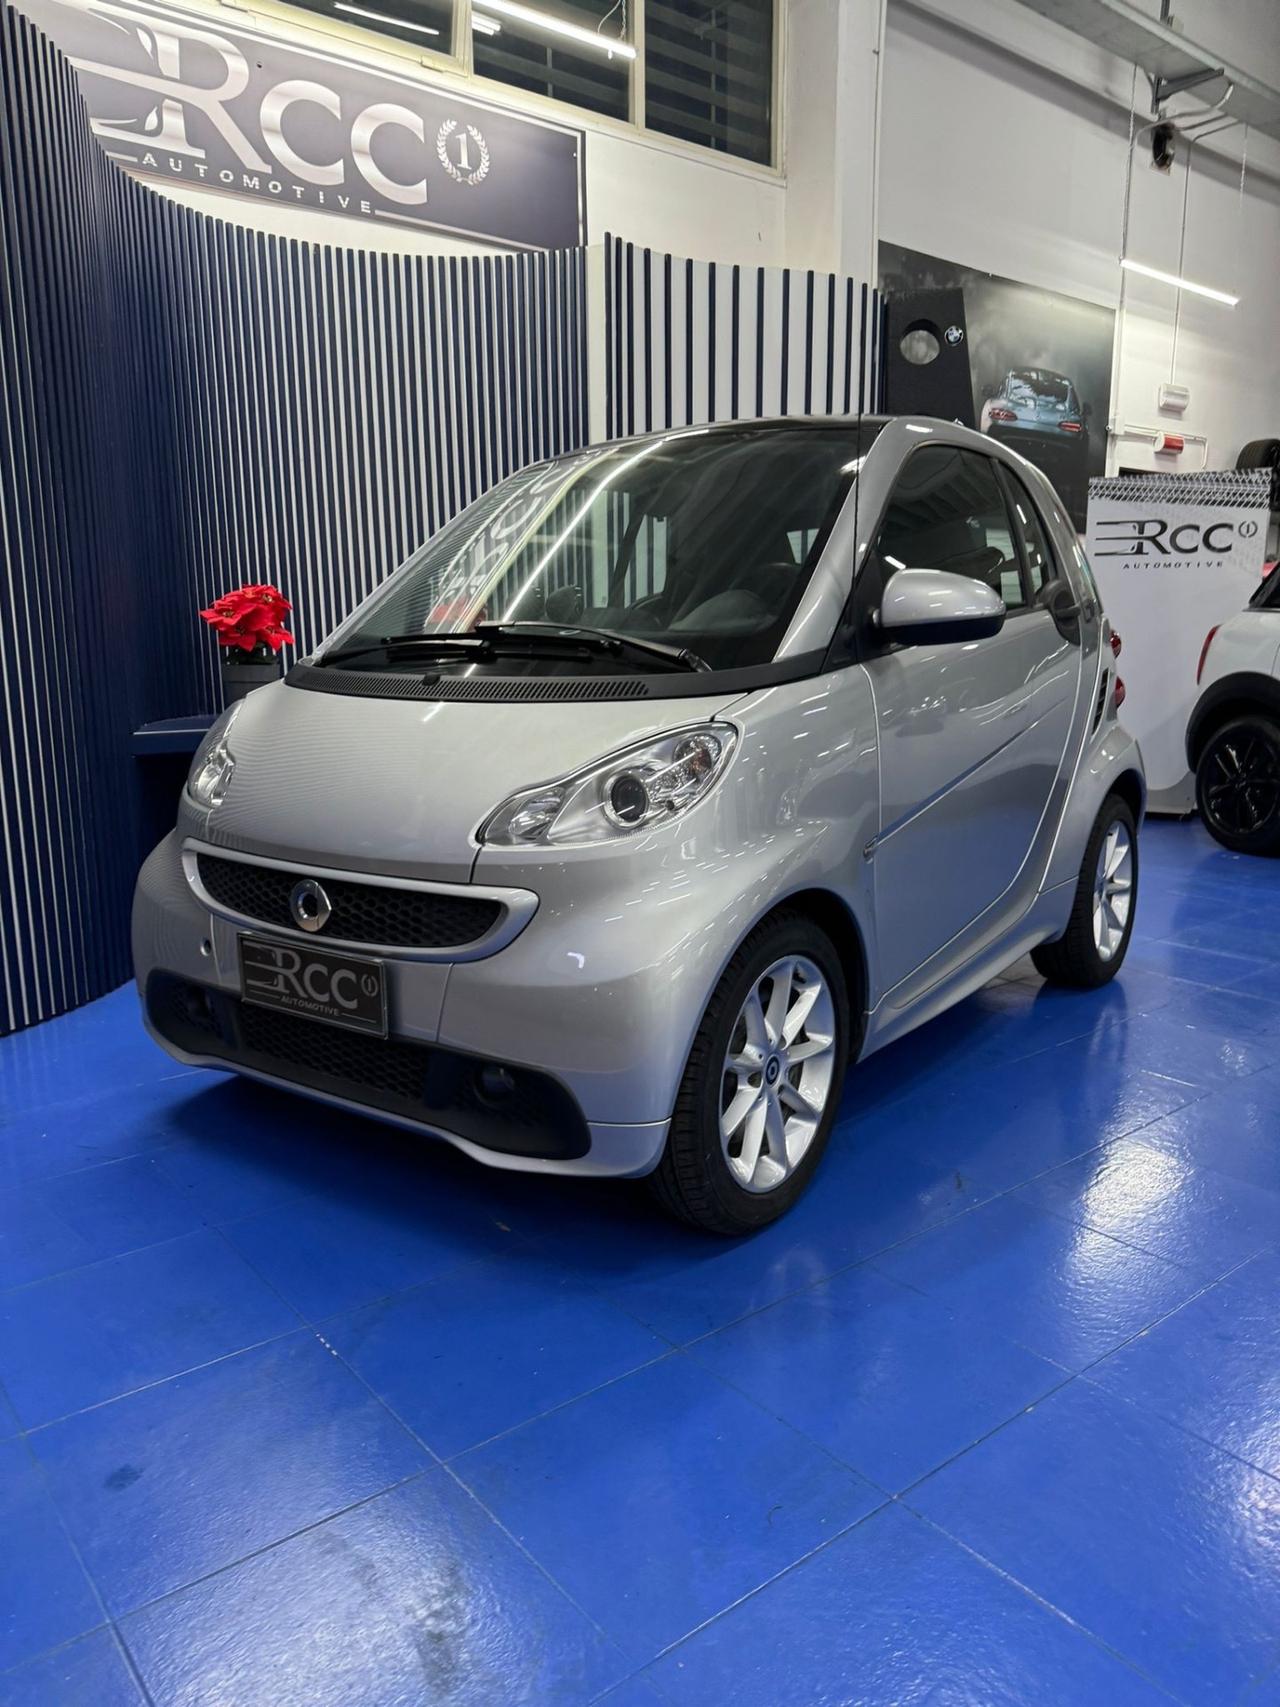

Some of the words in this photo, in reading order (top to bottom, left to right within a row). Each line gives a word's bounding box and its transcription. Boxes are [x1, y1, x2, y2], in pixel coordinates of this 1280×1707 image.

[64, 2, 428, 206] RCC
[141, 152, 373, 216] AUTOMOTIVE
[1094, 519, 1235, 556] RCC
[1122, 560, 1224, 570] AUTOMOTIVE
[243, 941, 359, 1010] RCC
[279, 994, 341, 1017] AUTOMOTIVE
